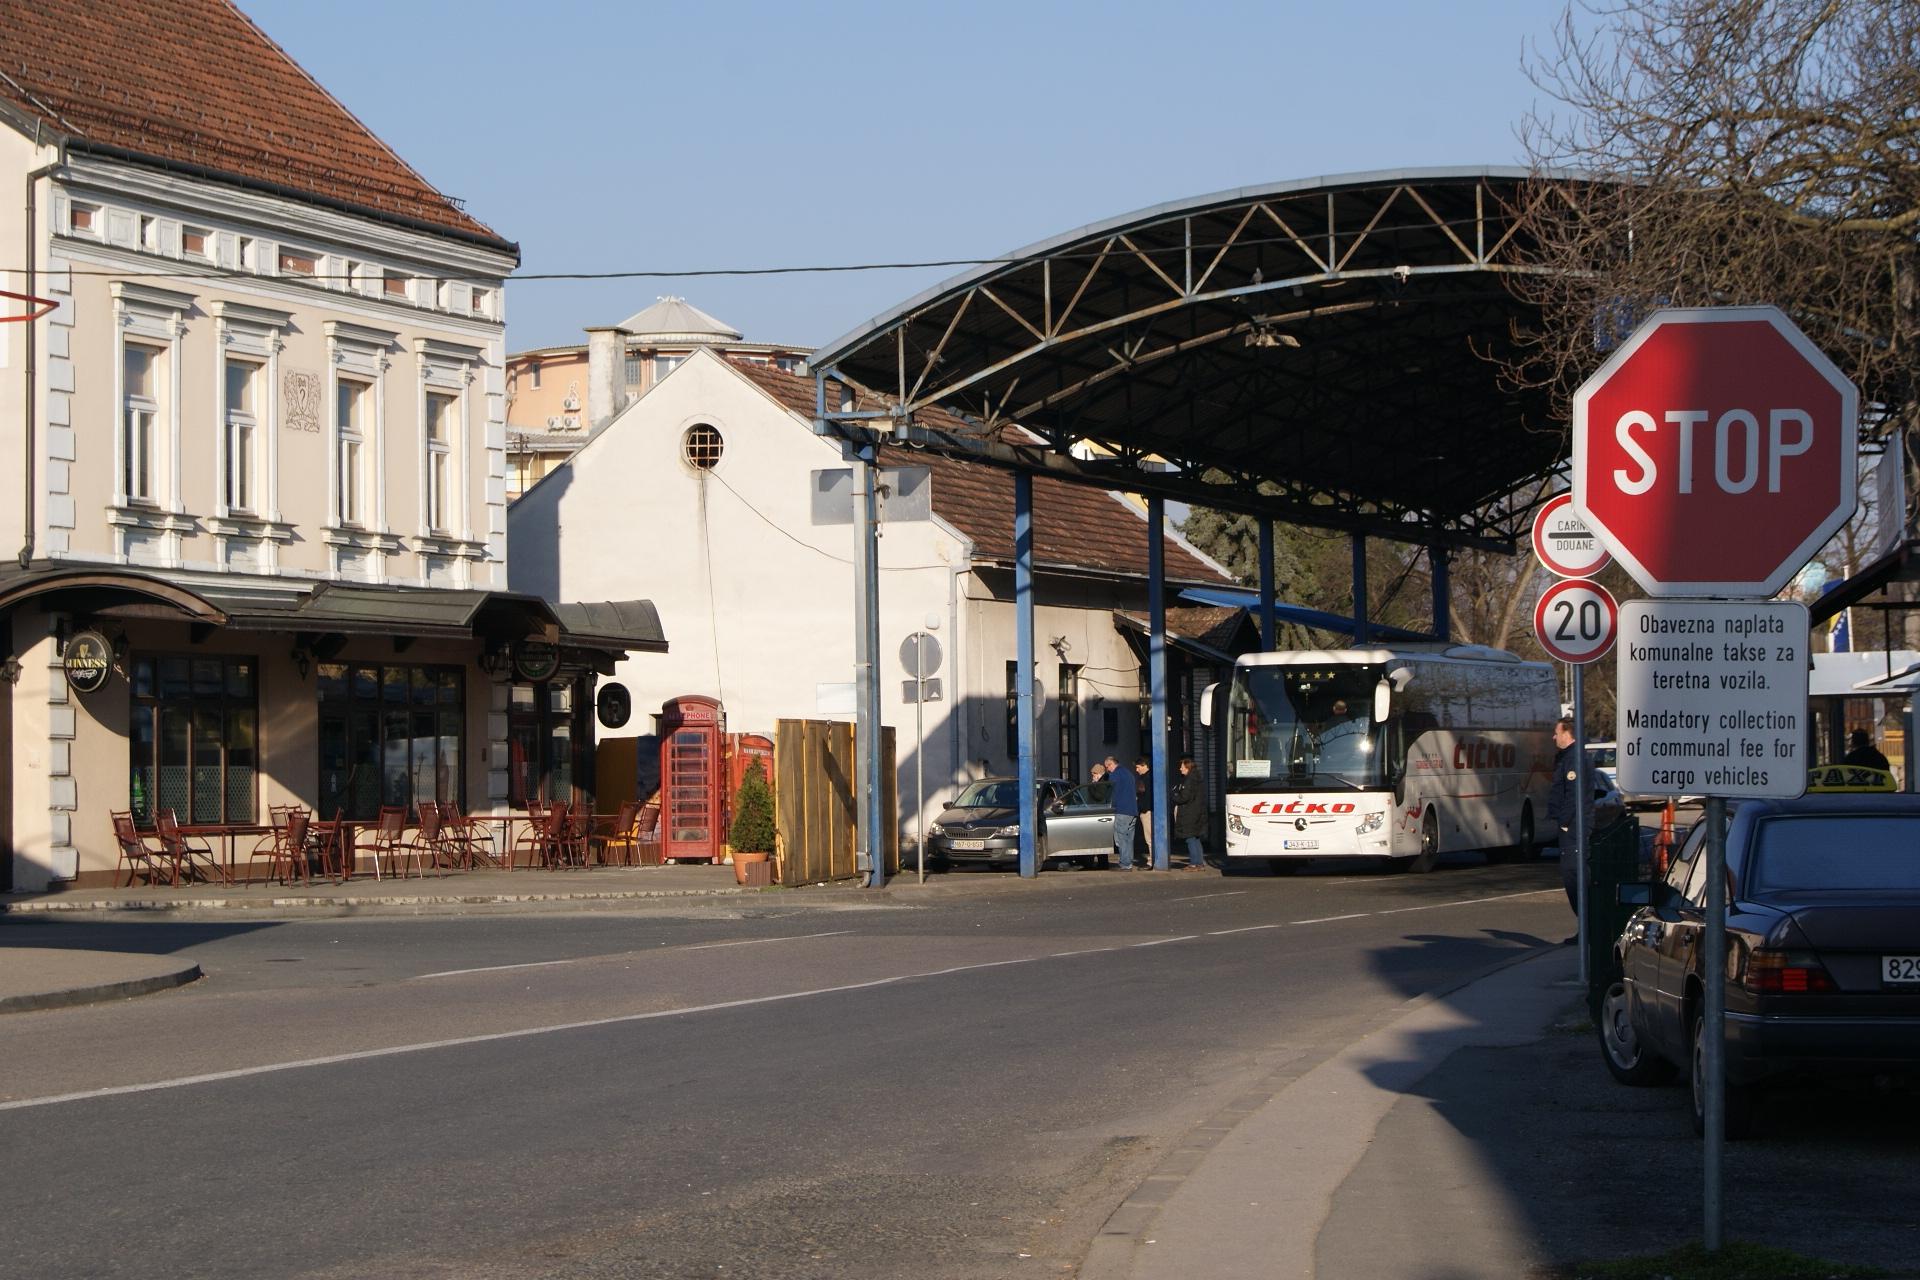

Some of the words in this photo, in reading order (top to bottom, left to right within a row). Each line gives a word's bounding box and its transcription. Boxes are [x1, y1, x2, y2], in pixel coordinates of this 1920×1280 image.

[1613, 408, 1814, 496] STOP
[1557, 520, 1588, 531] CARIN
[1556, 540, 1595, 551] DOUANE
[1554, 600, 1601, 641] 20
[1640, 614, 1715, 634] Obavezna
[1725, 614, 1784, 638] naplata
[1630, 642, 1713, 662] komunalne
[1723, 642, 1766, 662] takse
[1776, 647, 1794, 662] za
[66, 659, 107, 668] GUINNESS
[1653, 671, 1710, 690] teretna
[1720, 670, 1770, 690] vozila.
[1627, 710, 1710, 734] Mandatory
[1719, 710, 1796, 730] collection
[1627, 737, 1642, 756] of
[1650, 738, 1730, 757] communal
[1740, 738, 1764, 757] fee
[1774, 739, 1796, 758] for
[1652, 769, 1695, 789] cargo
[1705, 766, 1769, 786] vehicles
